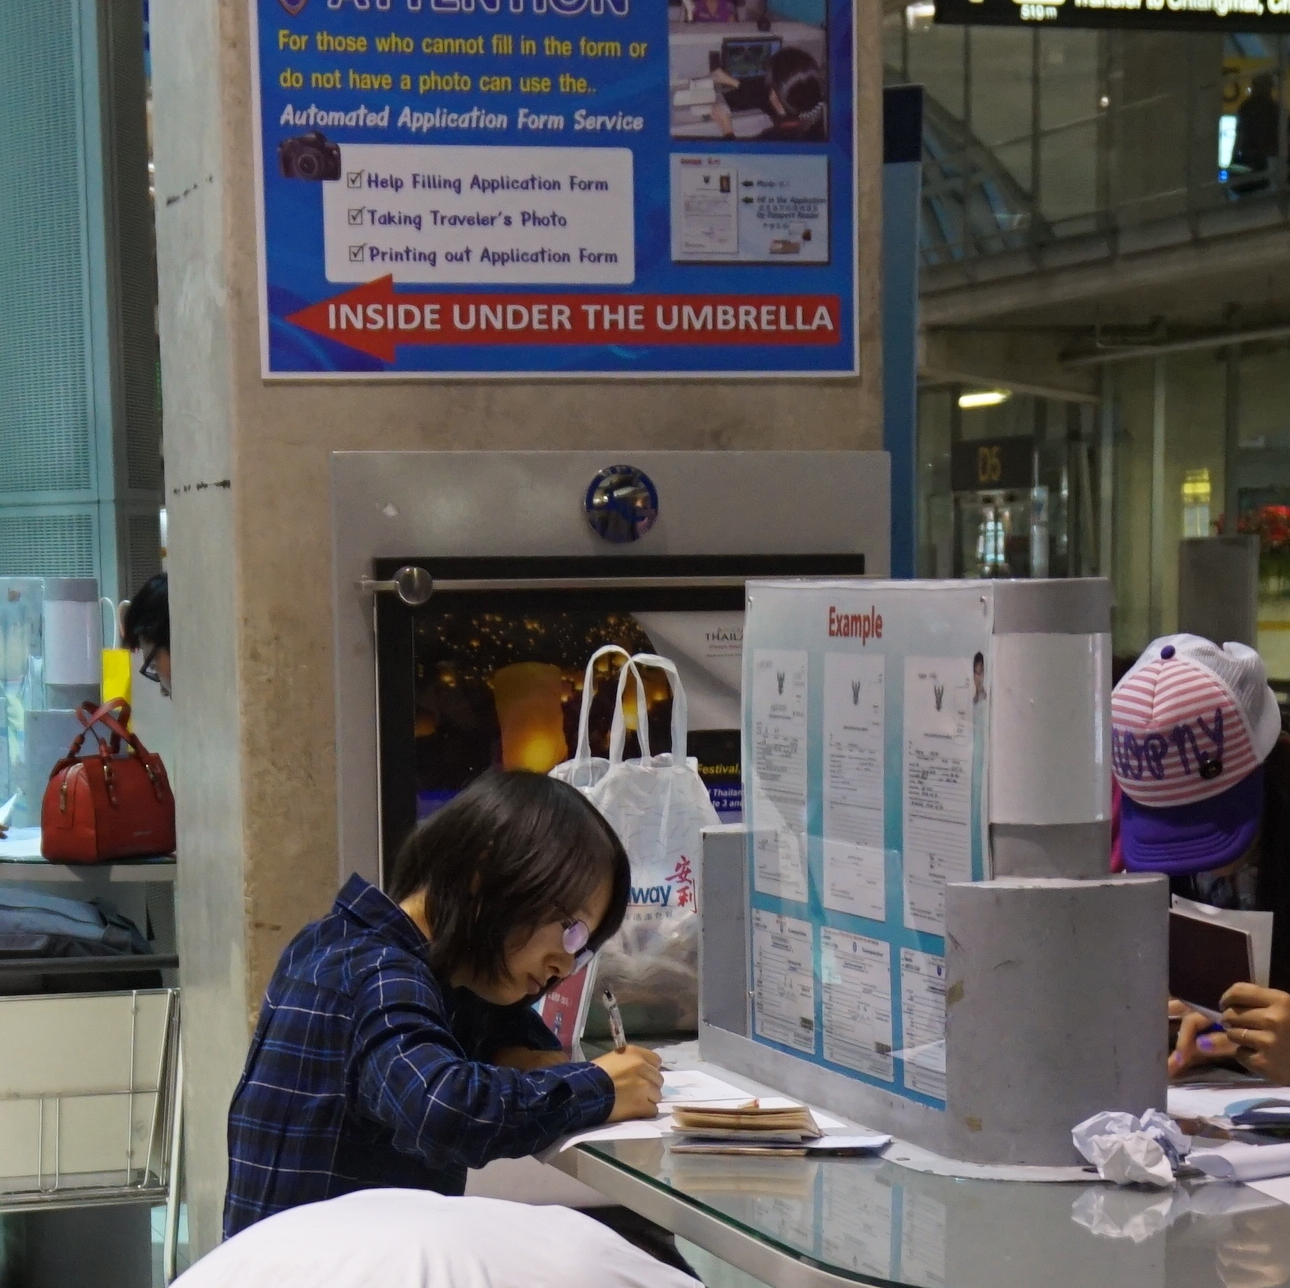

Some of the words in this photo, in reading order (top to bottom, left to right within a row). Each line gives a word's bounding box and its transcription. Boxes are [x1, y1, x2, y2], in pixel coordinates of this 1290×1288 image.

[278, 29, 308, 50] For
[316, 31, 368, 51] those
[375, 32, 414, 53] who
[421, 35, 484, 54] cannot
[492, 34, 513, 55] fill
[520, 35, 537, 55] in
[544, 36, 572, 56] the
[579, 36, 621, 57] form
[629, 42, 648, 58] or
[279, 67, 303, 88] do
[311, 69, 342, 89] not
[349, 69, 392, 89] have
[400, 74, 412, 90] a
[419, 70, 471, 94] photo
[479, 75, 511, 91] can
[519, 77, 551, 92] use
[280, 103, 390, 127] Automated
[398, 106, 508, 132] Application
[517, 108, 565, 130] Form
[574, 109, 644, 131] Service
[367, 172, 404, 192] Help
[411, 173, 462, 194] Filling
[470, 174, 561, 194] Application
[569, 175, 609, 191] Form
[367, 209, 422, 231] Taking
[430, 210, 513, 226] Traveler's
[520, 209, 567, 227] Photo
[369, 245, 437, 267] Printing
[444, 246, 472, 262] out
[480, 246, 571, 266] Application
[579, 248, 618, 263] Form
[328, 303, 441, 329] INSIDE
[452, 304, 572, 330] UNDER
[581, 304, 644, 330] THE
[656, 304, 835, 331] UMBRELLA
[705, 633, 743, 641] THAIL
[827, 605, 883, 646] Example
[629, 885, 672, 907] way
